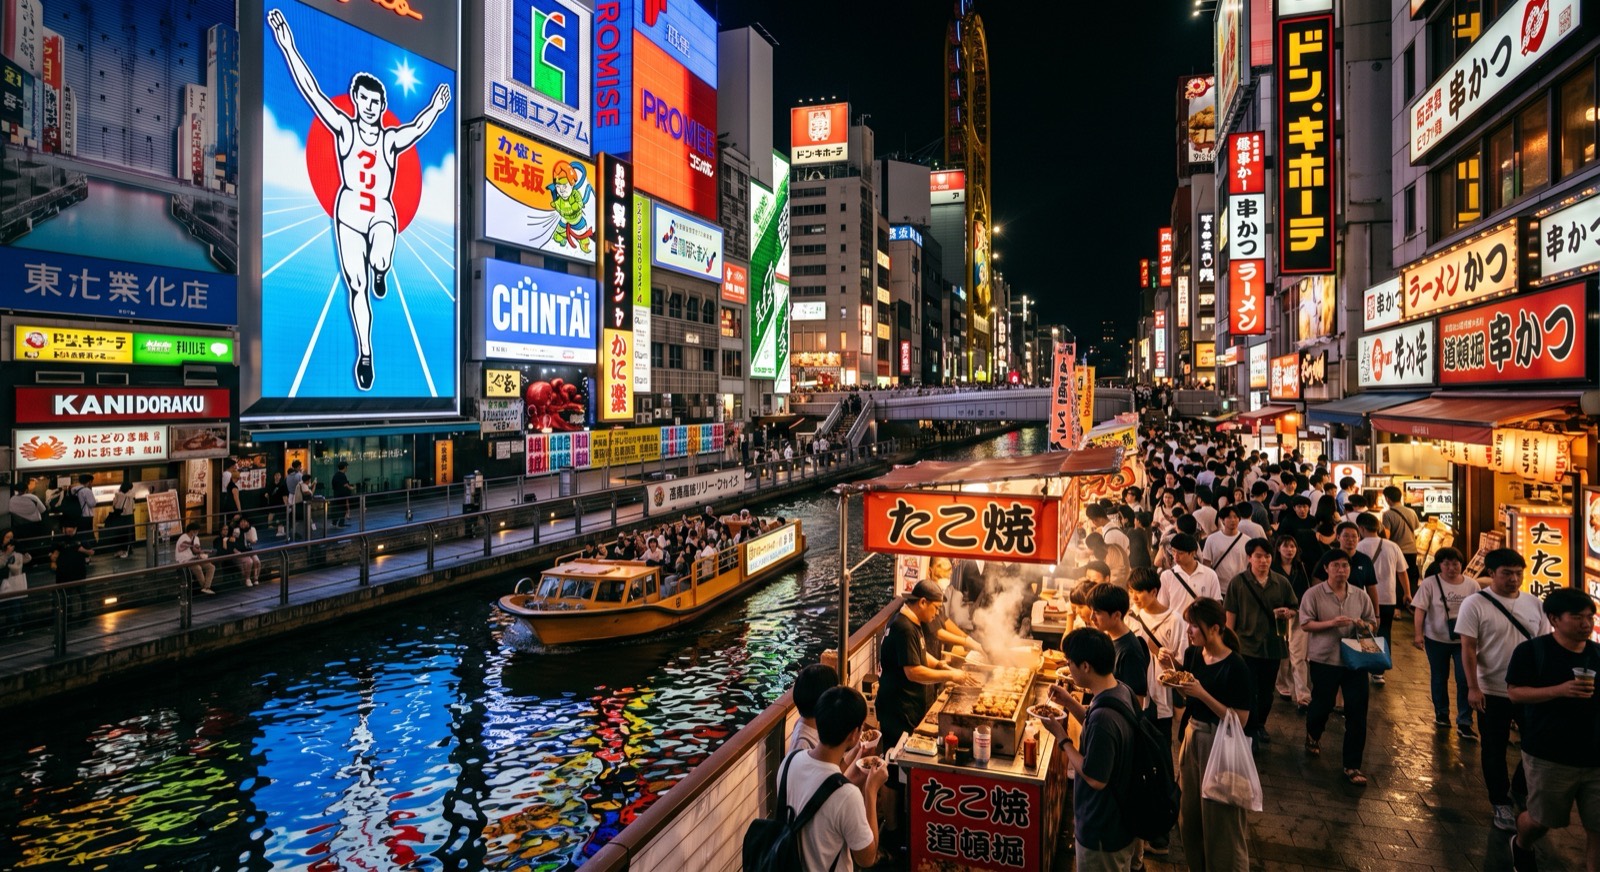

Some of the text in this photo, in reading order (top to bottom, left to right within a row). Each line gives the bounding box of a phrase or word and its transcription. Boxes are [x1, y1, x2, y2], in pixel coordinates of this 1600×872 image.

[1449, 35, 1512, 121] 串かつ
[1289, 30, 1324, 252] ドン・キホーテ
[1237, 199, 1258, 255] 串かつ
[1238, 263, 1257, 331] ラーメン
[1409, 243, 1508, 308] ラーメンかつ
[1490, 304, 1576, 373] 串かつ
[889, 499, 1034, 553] たこ焼
[922, 778, 1029, 827] たこ焼
